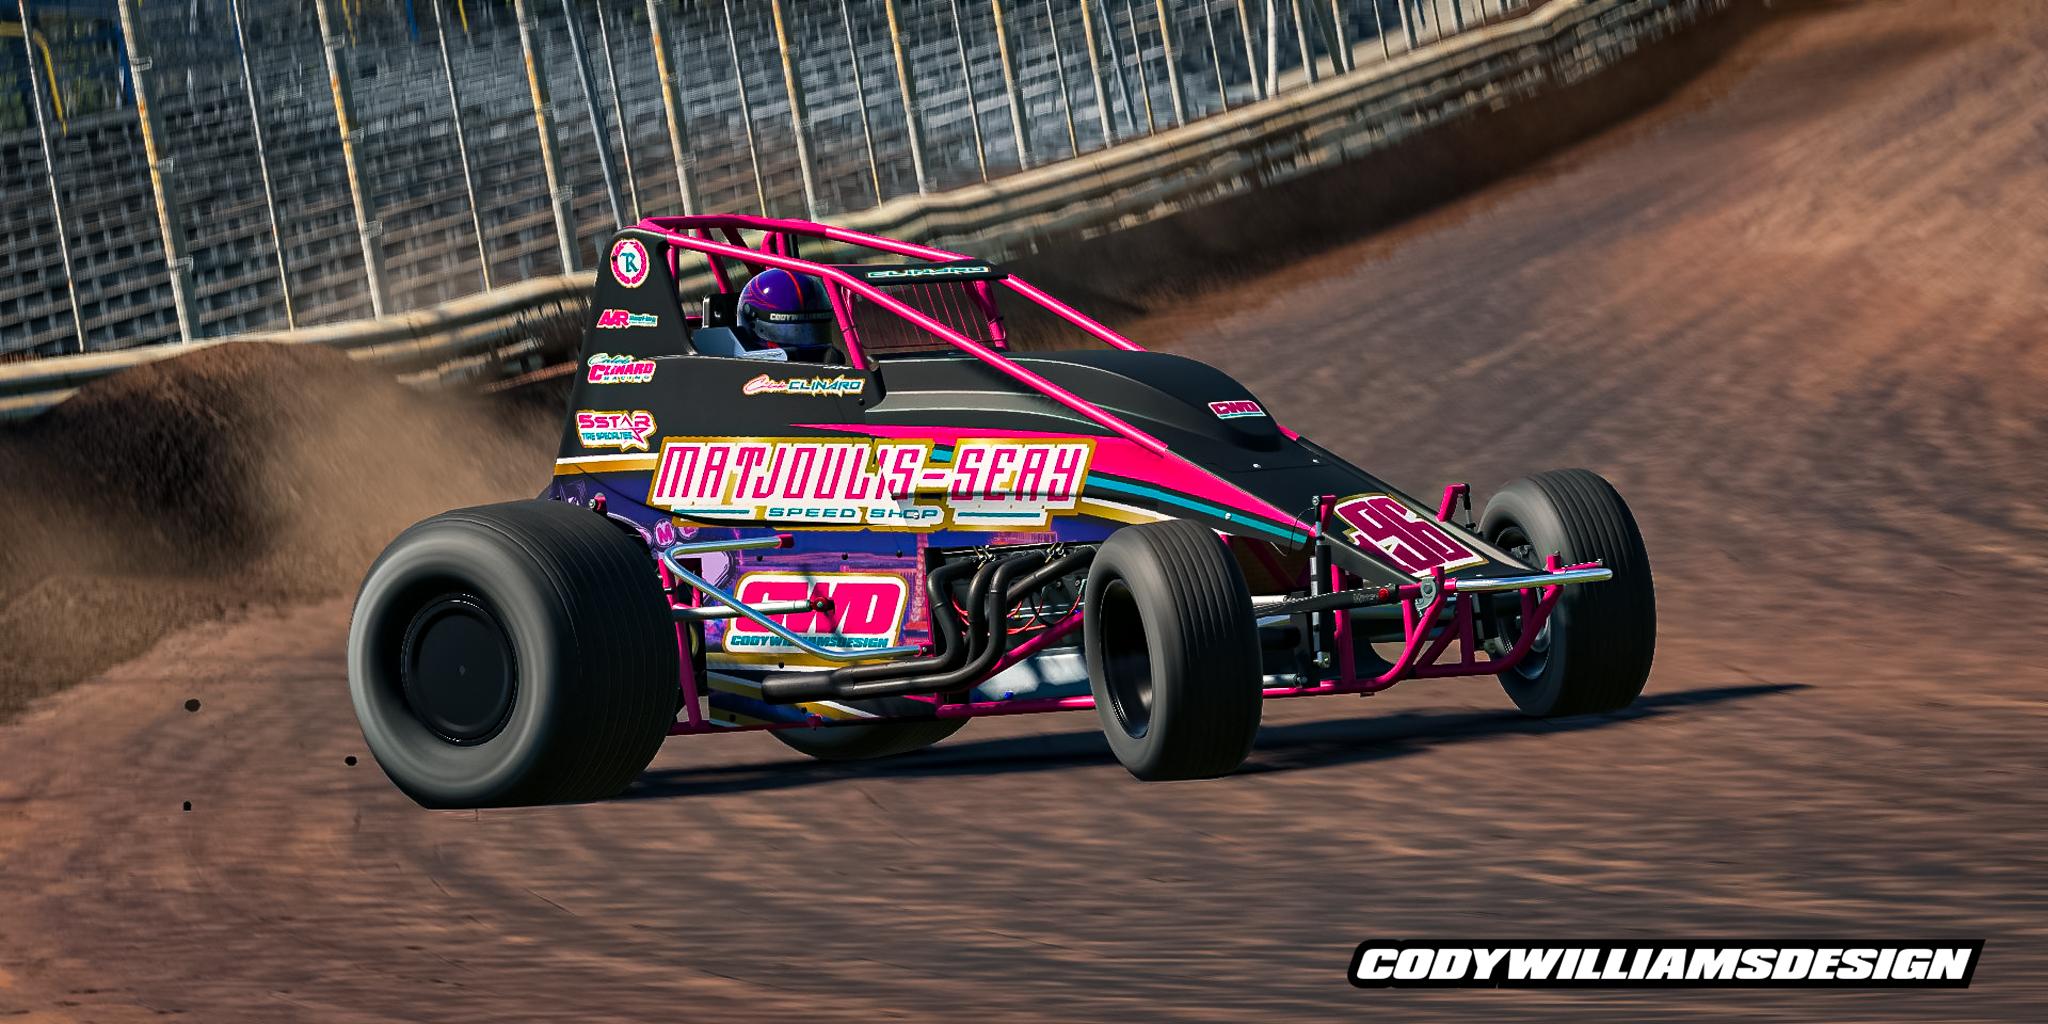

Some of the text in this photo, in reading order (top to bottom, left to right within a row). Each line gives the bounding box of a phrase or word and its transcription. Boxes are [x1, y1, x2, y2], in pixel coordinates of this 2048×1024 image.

[768, 507, 938, 519] SPEED SHOP
[735, 581, 901, 634] CWD
